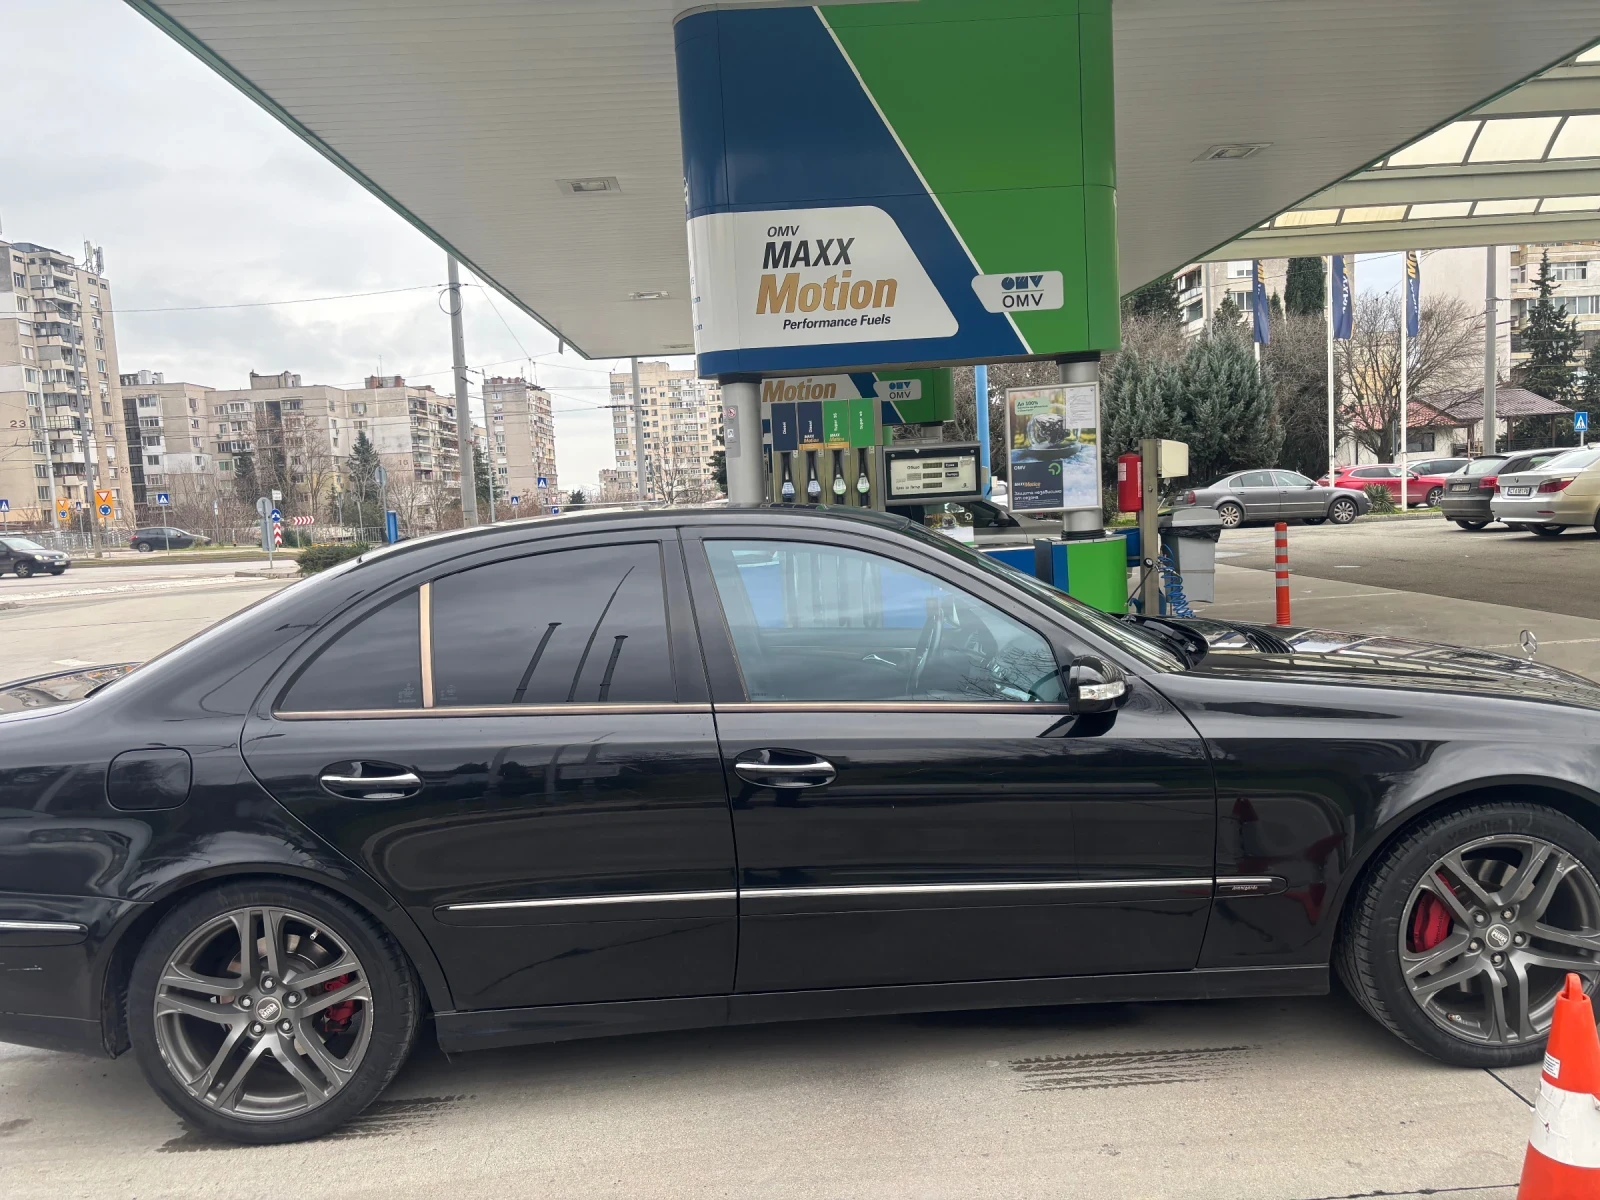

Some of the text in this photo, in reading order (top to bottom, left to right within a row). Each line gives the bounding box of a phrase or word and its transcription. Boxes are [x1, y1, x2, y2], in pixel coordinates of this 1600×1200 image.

[767, 225, 800, 238] OMV
[762, 237, 856, 270] MAXX
[756, 269, 898, 315] Motion
[1002, 292, 1044, 309] OMV
[783, 313, 892, 331] Performance Fuels
[762, 378, 837, 403] Motion
[889, 391, 911, 399] OMV
[10, 419, 27, 428] 23
[120, 466, 129, 474] 23
